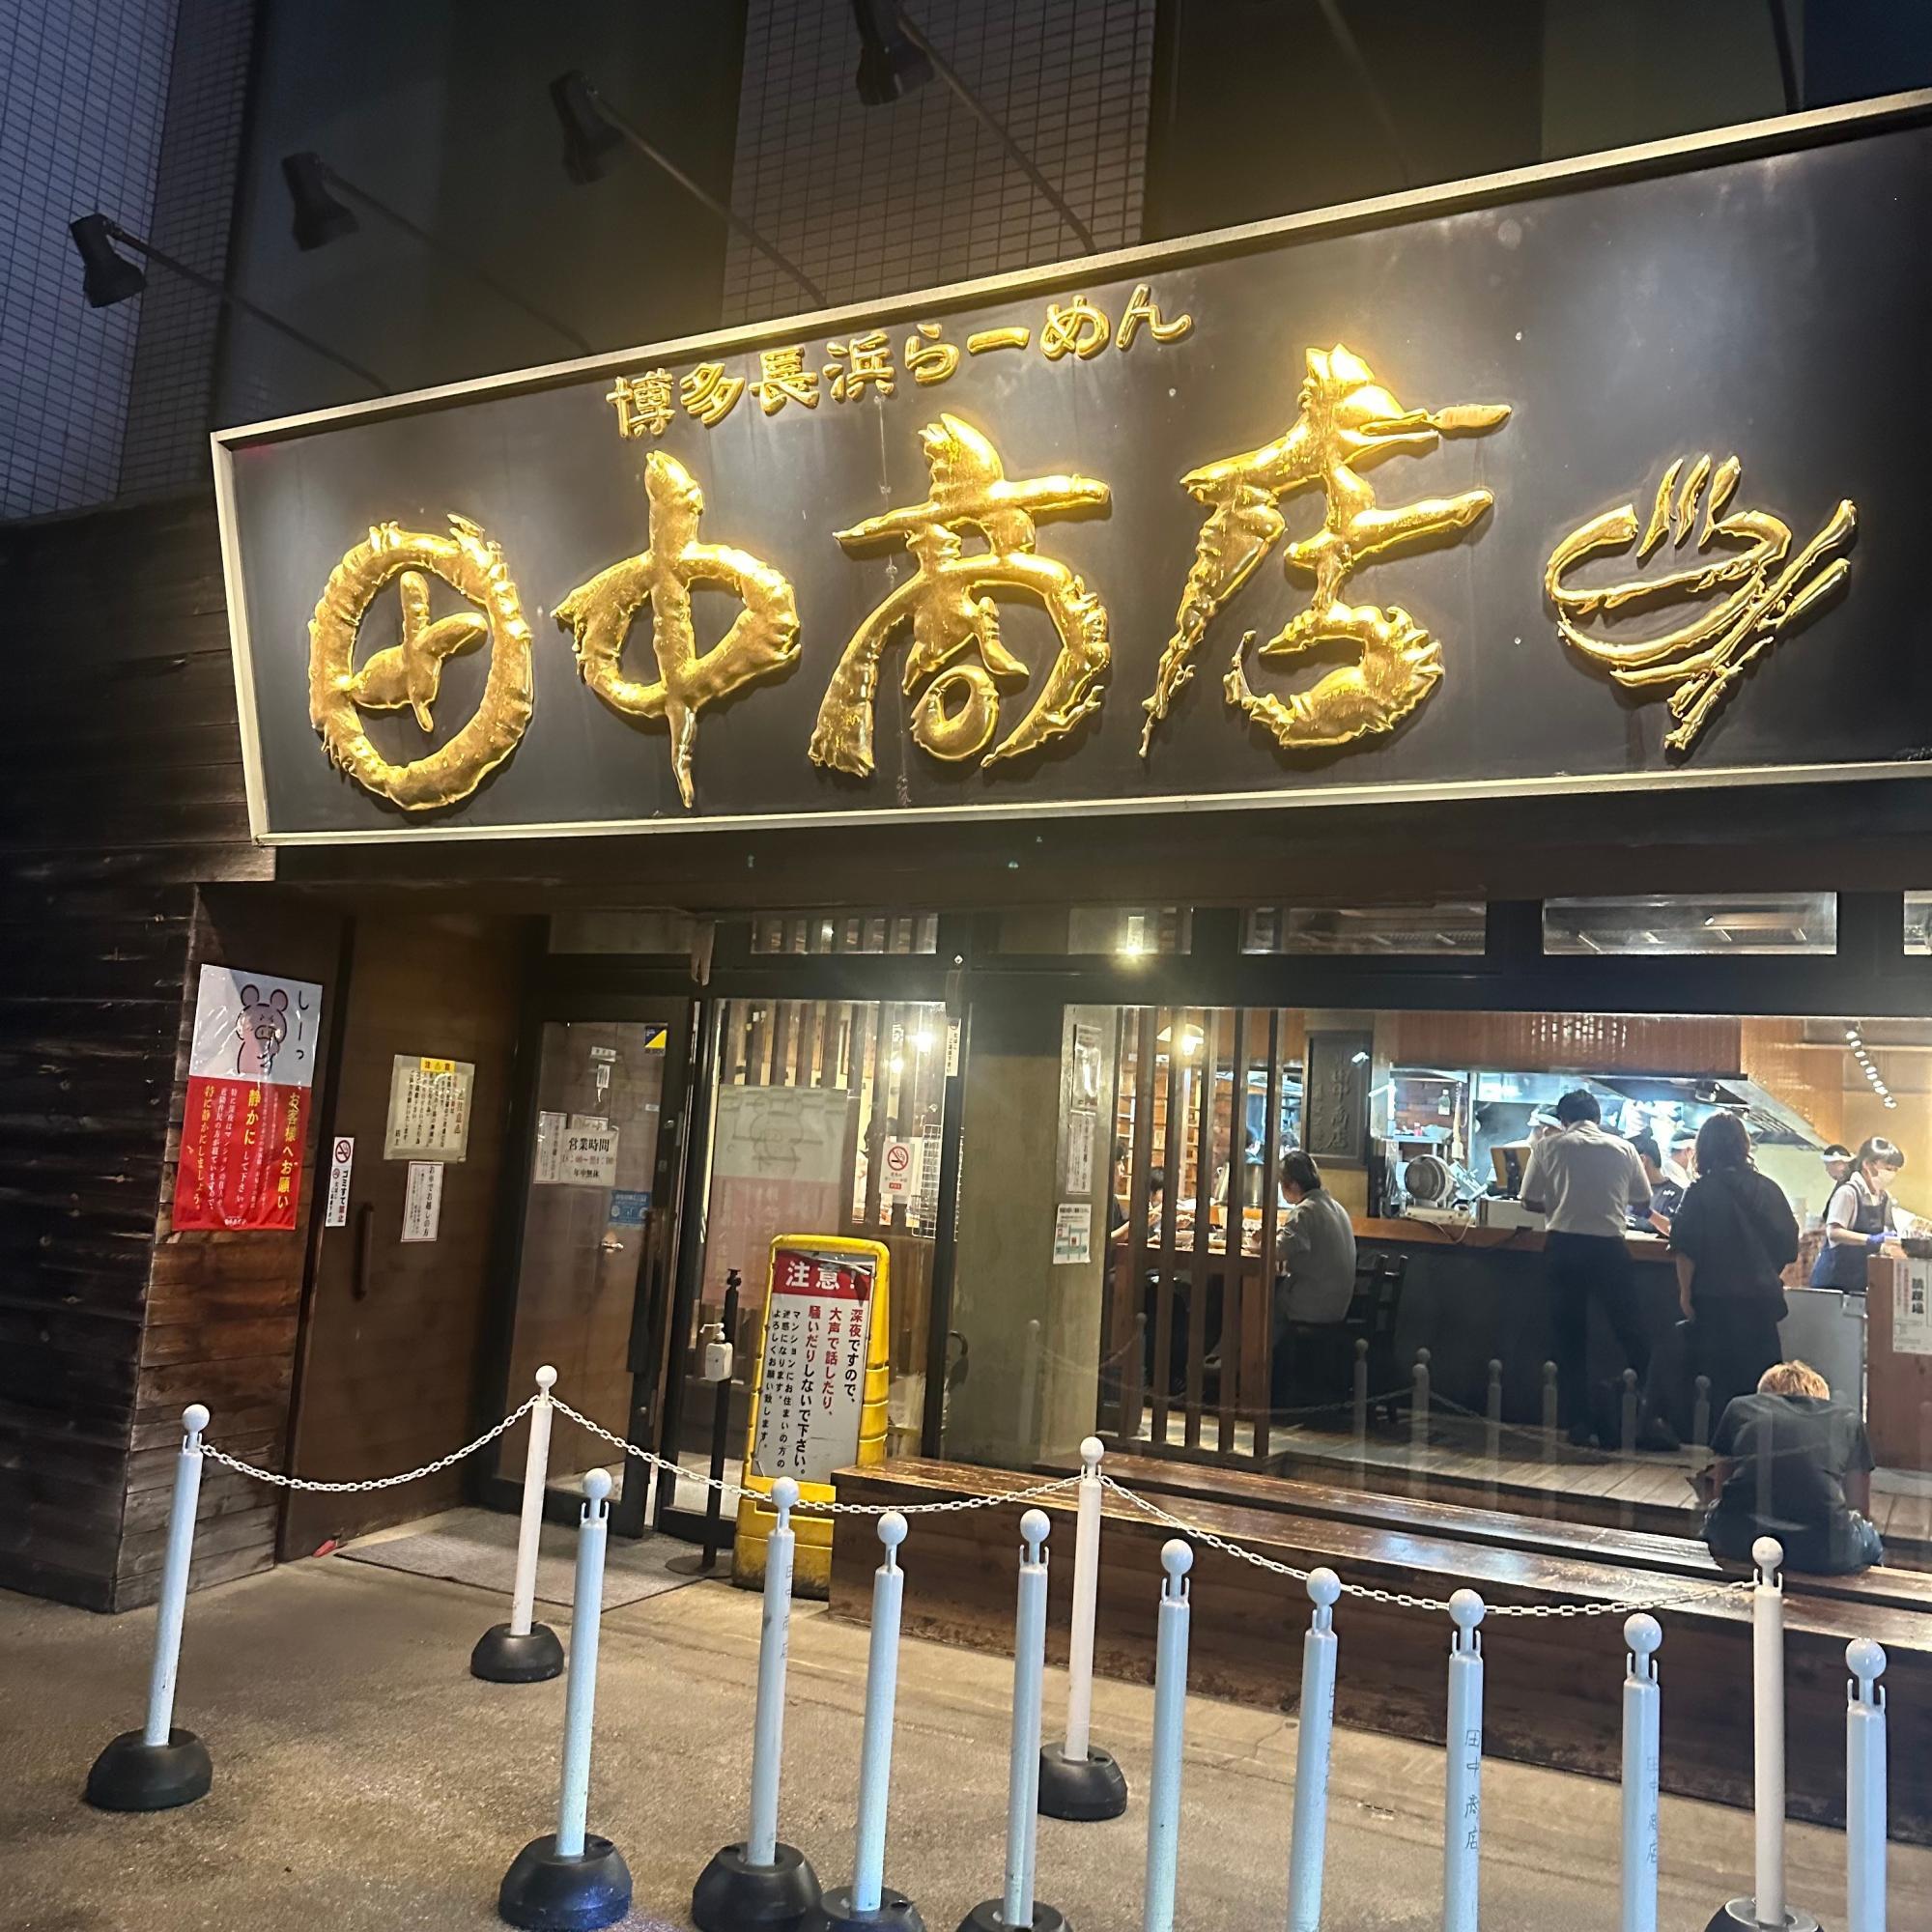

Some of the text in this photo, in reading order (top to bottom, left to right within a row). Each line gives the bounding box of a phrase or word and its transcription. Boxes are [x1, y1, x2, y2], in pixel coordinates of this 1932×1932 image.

[606, 284, 1193, 440] 博多長浜らーめん
[307, 345, 1512, 812] 田中商店
[296, 989, 309, 1061] しーっ
[236, 1089, 261, 1209] 静かにして下さい。
[277, 1092, 300, 1209] お客様へお願い
[568, 1137, 611, 1152] 営業時間
[759, 1309, 781, 1448] よろしくお願い致します。
[775, 1310, 790, 1401] 迷惑になります。
[776, 1310, 801, 1469] マンションにお住まいの方の
[794, 1305, 821, 1475] 騒いだりしないで下さい。
[821, 1307, 842, 1416] 大声で話したり、
[843, 1308, 864, 1404] 深夜ですので、
[1464, 1729, 1481, 1850] 田中商店
